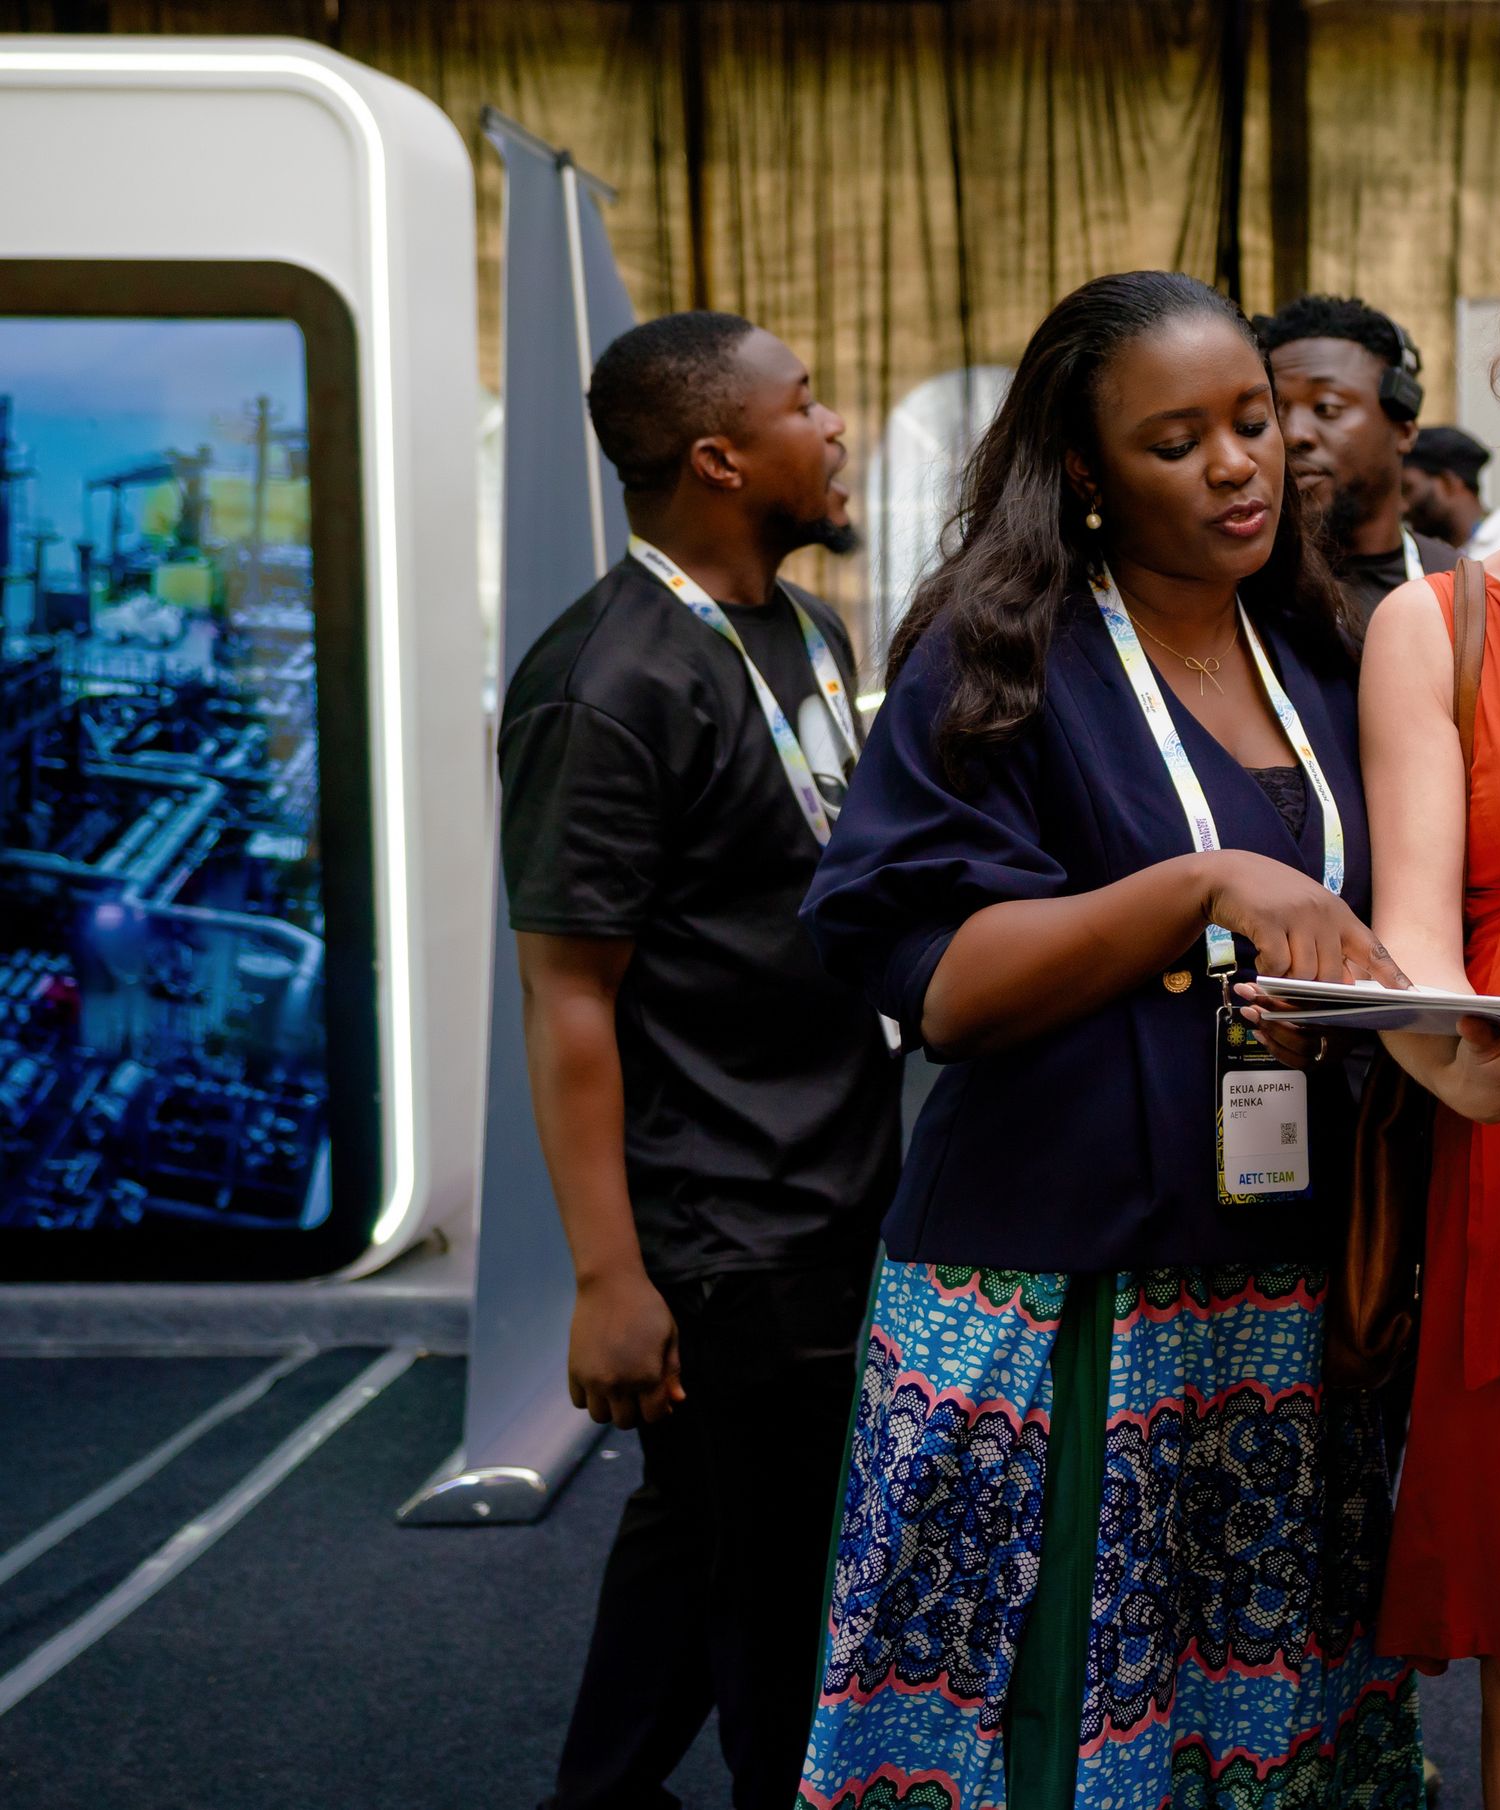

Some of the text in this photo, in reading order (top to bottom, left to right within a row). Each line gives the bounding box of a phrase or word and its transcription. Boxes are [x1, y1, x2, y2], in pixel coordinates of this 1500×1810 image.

[1306, 760, 1329, 802] Sonangol
[1230, 1083, 1294, 1094] EKUA APPIAH-
[1230, 1097, 1263, 1107] MENKA
[1230, 1111, 1247, 1119] AETC
[1239, 1171, 1294, 1185] AETC TEAM
